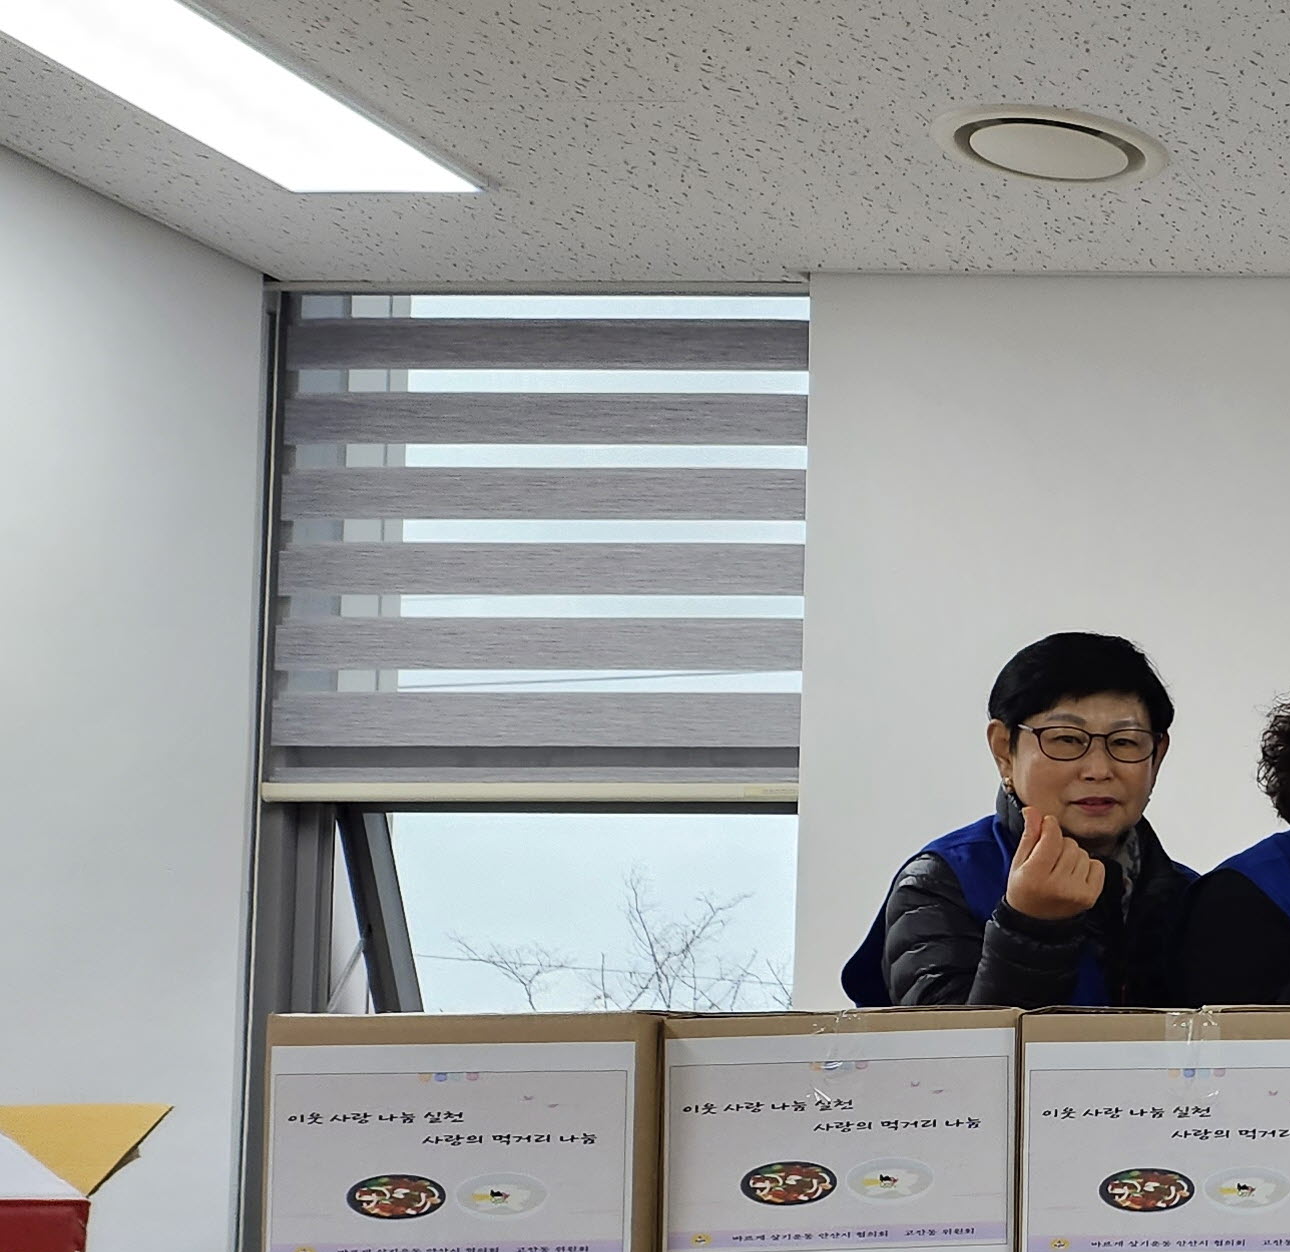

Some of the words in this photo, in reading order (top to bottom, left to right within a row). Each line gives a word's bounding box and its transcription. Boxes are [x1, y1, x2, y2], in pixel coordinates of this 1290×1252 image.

[288, 1113, 323, 1125] 이웃
[330, 1113, 372, 1124] 사랑
[378, 1112, 415, 1124] 나눔
[424, 1111, 464, 1123] 실천
[1042, 1107, 1076, 1119] 이웃
[1083, 1107, 1123, 1119] 사랑
[1129, 1107, 1164, 1118] 나눔
[1173, 1106, 1211, 1118] 실천
[422, 1134, 483, 1146] 사랑의
[492, 1133, 550, 1145] 먹거리
[559, 1133, 597, 1144] 나눔
[1172, 1129, 1229, 1140] 사랑의
